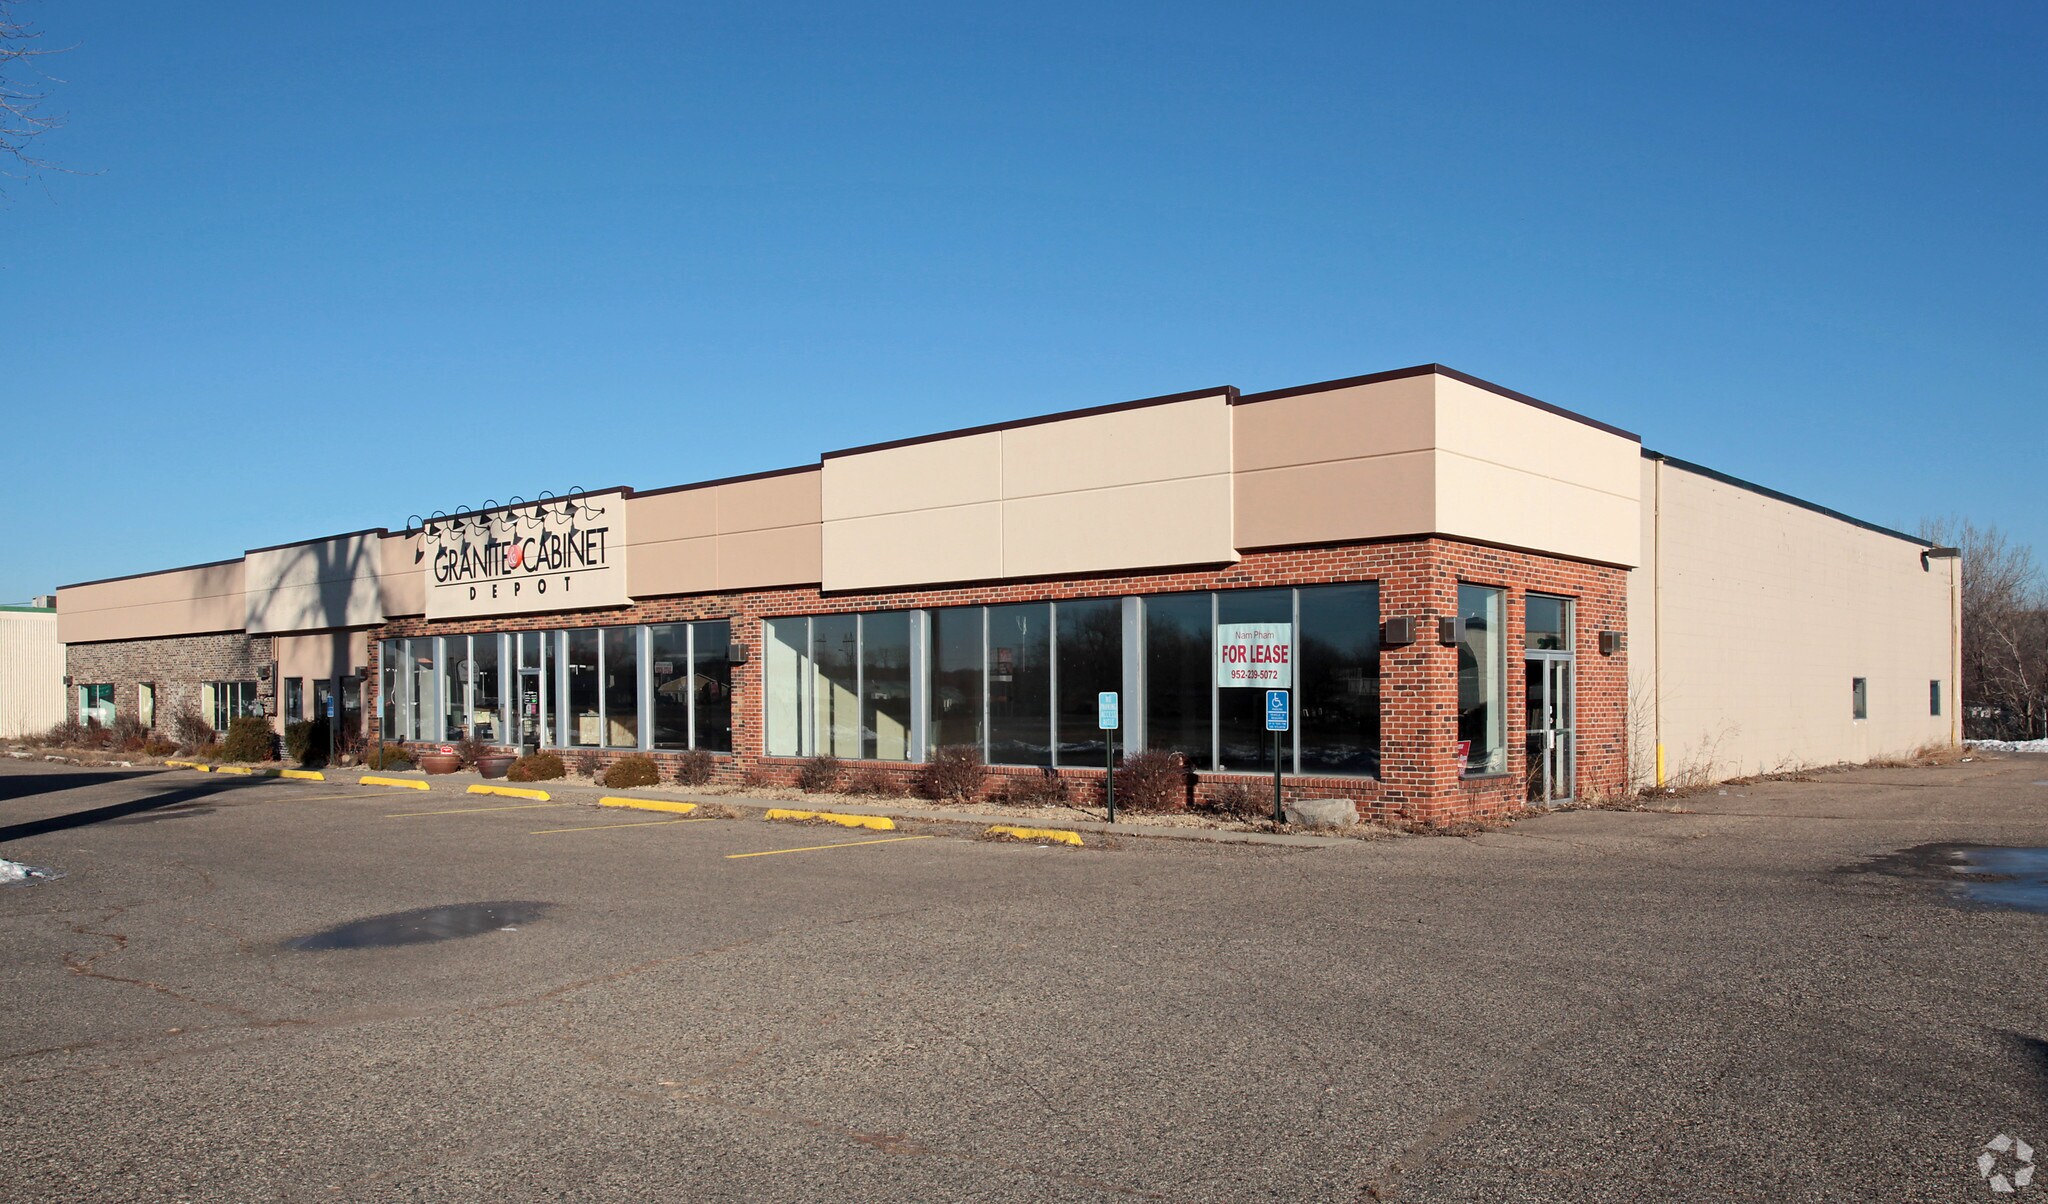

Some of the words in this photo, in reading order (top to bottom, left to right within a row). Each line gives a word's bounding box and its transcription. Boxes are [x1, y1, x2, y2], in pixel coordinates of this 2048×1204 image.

[434, 541, 512, 583] GRANITE
[522, 527, 609, 573] CABINET
[470, 576, 570, 600] DEPOT
[1235, 631, 1253, 640] Nam
[1254, 630, 1275, 640] Pham
[1222, 645, 1247, 663] FOR
[1250, 645, 1289, 663] LEASE
[1231, 670, 1278, 679] 952-239-5072
